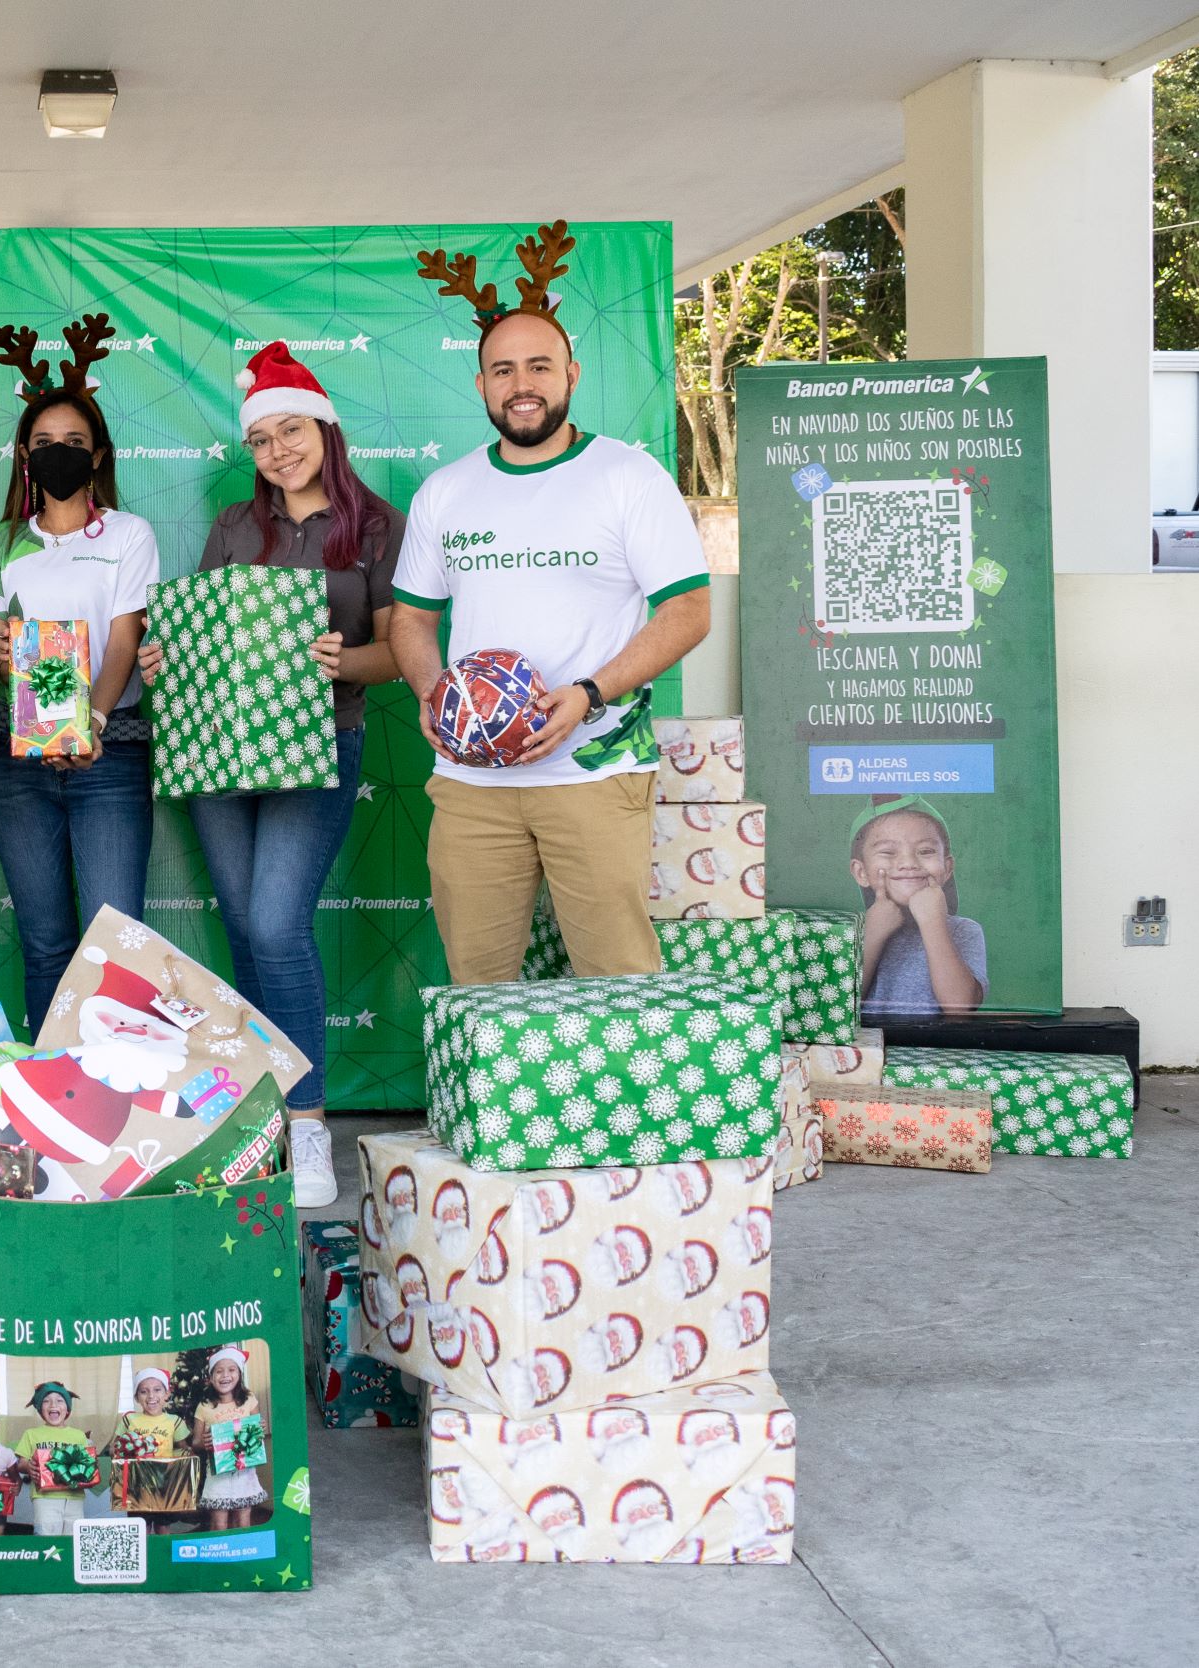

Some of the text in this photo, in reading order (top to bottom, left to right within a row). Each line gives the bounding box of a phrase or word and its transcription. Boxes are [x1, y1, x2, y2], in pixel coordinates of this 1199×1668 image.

[284, 338, 345, 351] romerica
[786, 376, 954, 398] Banco Promerica
[772, 406, 1014, 435] EN NAVIDAD LOS SUEÑOS DE LAS
[133, 446, 201, 459] Promerica
[347, 445, 416, 459] Promerica
[766, 438, 1023, 466] NIÑAS Y LOS NIÑOS SON POSIBLES
[445, 547, 598, 573] Promericano
[816, 644, 982, 671] ¡ESCANEA Y DONA!
[827, 678, 973, 698] Y HAGAMOS REALIDAD
[808, 703, 993, 726] CIENTOS DE ILUSIONES
[858, 757, 907, 769] ALDEAS
[858, 771, 960, 783] INFANTILES SOS
[144, 897, 204, 910] romerica
[317, 896, 420, 910] anco Promerica
[14, 1321, 35, 1345] DE
[44, 1321, 64, 1345] LA
[74, 1316, 143, 1344] SONRISA
[151, 1316, 171, 1341] DE
[181, 1311, 206, 1338] LOS
[214, 1300, 263, 1331] NIÑOS
